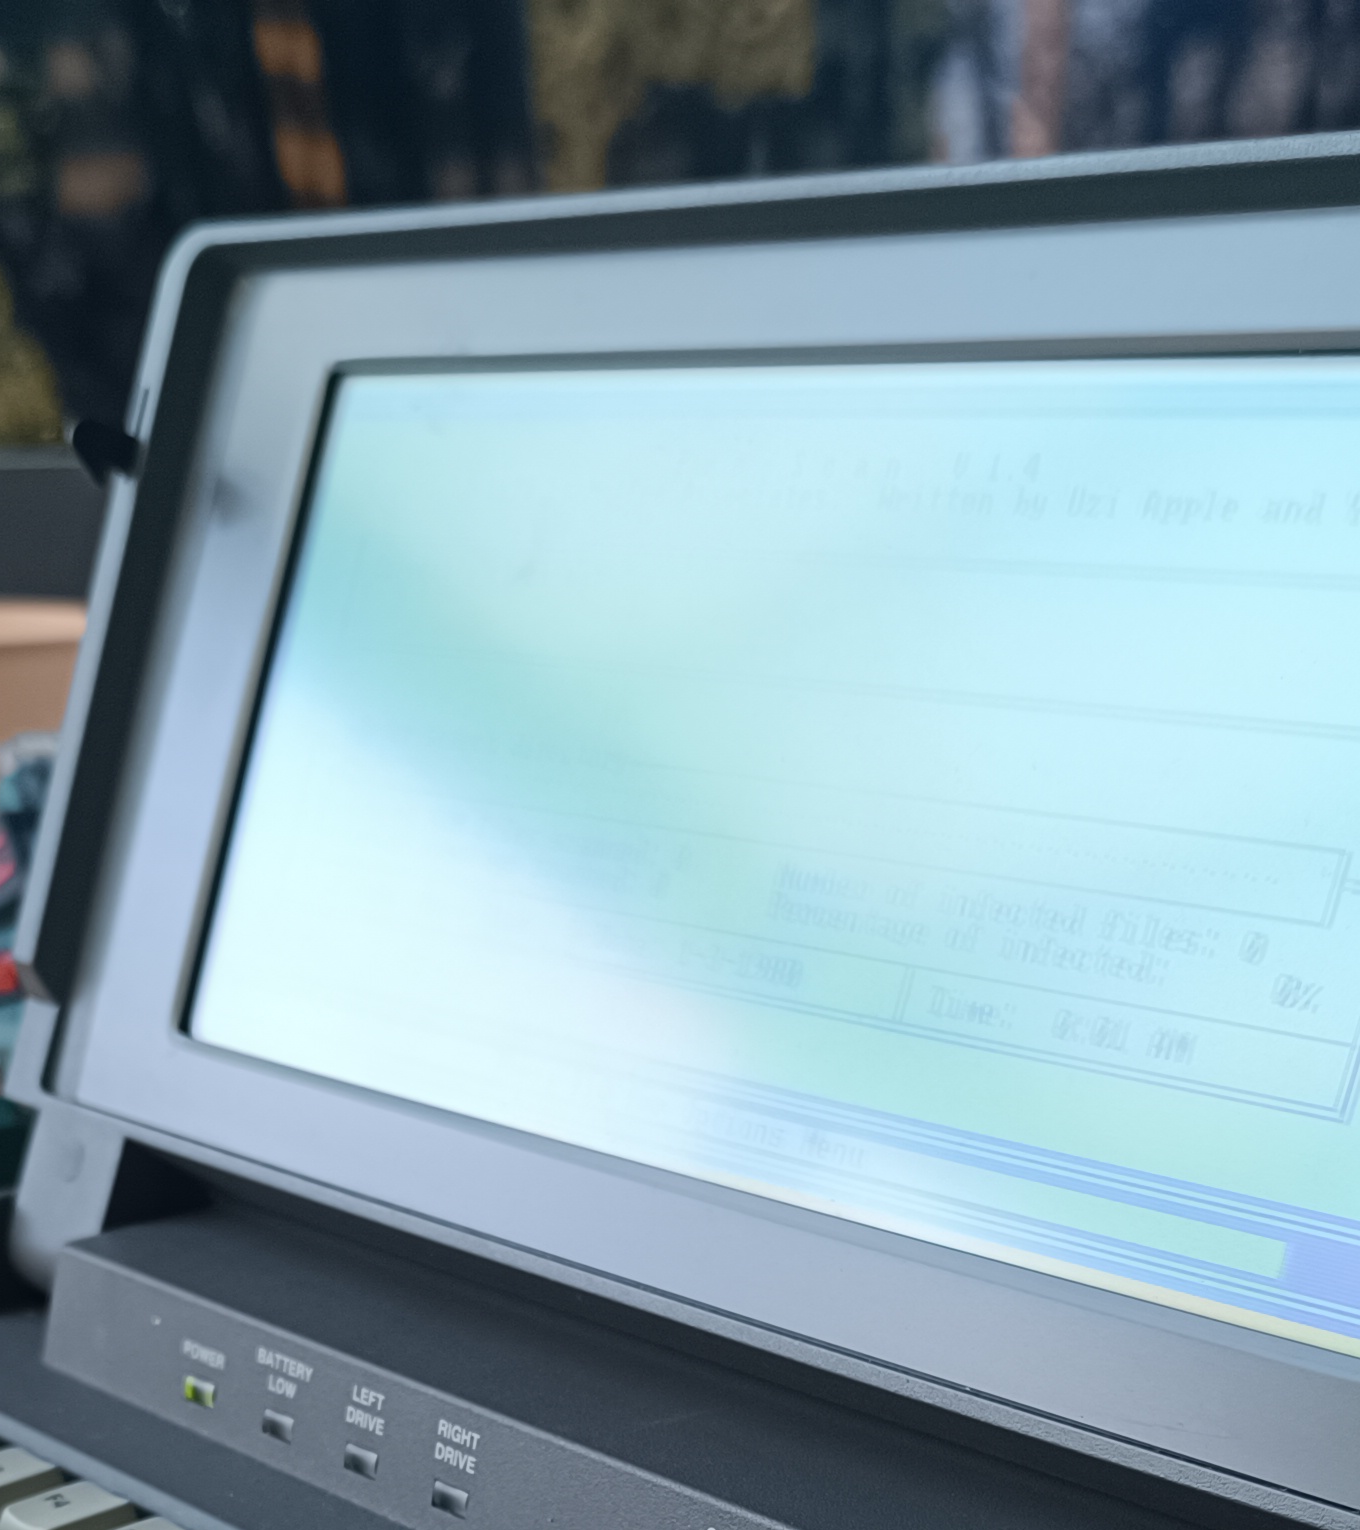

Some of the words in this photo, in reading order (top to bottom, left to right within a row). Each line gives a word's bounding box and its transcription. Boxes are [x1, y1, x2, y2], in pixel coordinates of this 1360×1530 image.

[1141, 487, 1240, 525] Apple
[1260, 491, 1326, 527] and
[182, 1339, 226, 1370] POWER
[257, 1347, 313, 1383] BATTERY
[268, 1376, 297, 1398] LOW
[352, 1385, 385, 1412] LEFT
[346, 1407, 385, 1436] DRIVE
[437, 1420, 481, 1451] RIGHT
[434, 1443, 476, 1474] DRIVE
